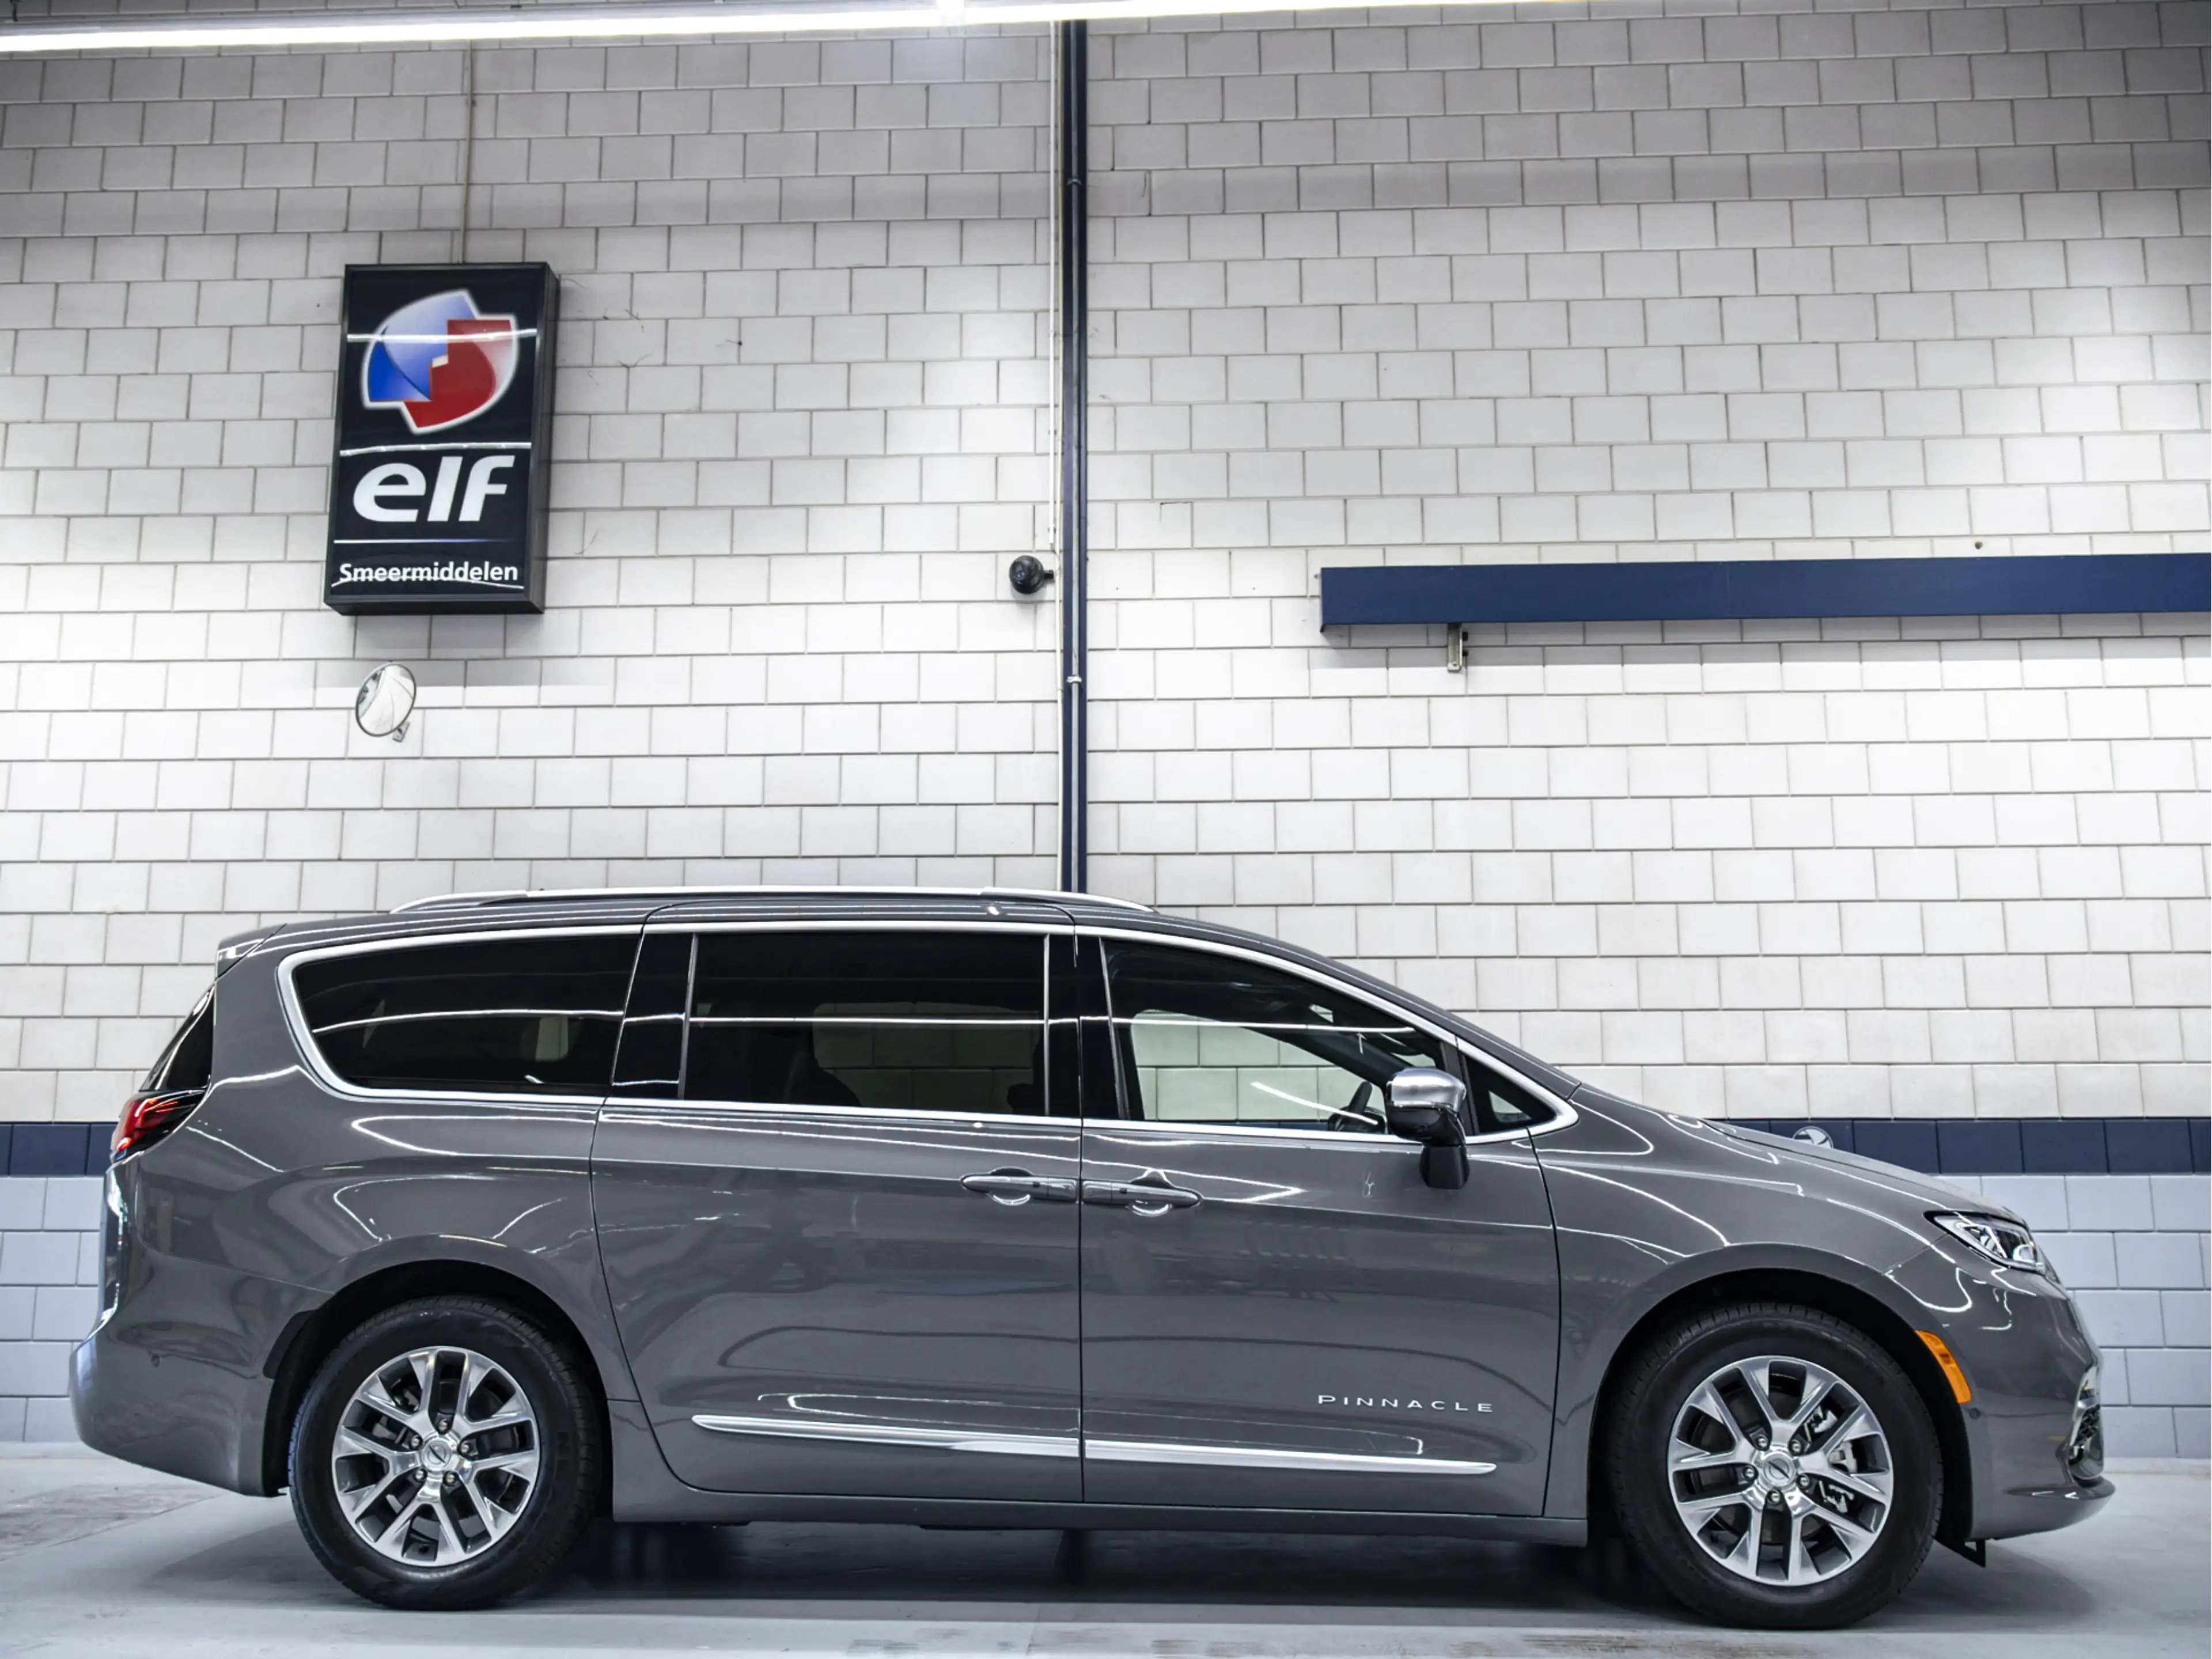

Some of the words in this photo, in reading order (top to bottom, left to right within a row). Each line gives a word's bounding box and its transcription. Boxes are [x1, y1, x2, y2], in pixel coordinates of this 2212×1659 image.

[353, 455, 516, 522] elf
[339, 560, 518, 582] Smeermiddelen
[1318, 1395, 1493, 1412] PINNACLE
